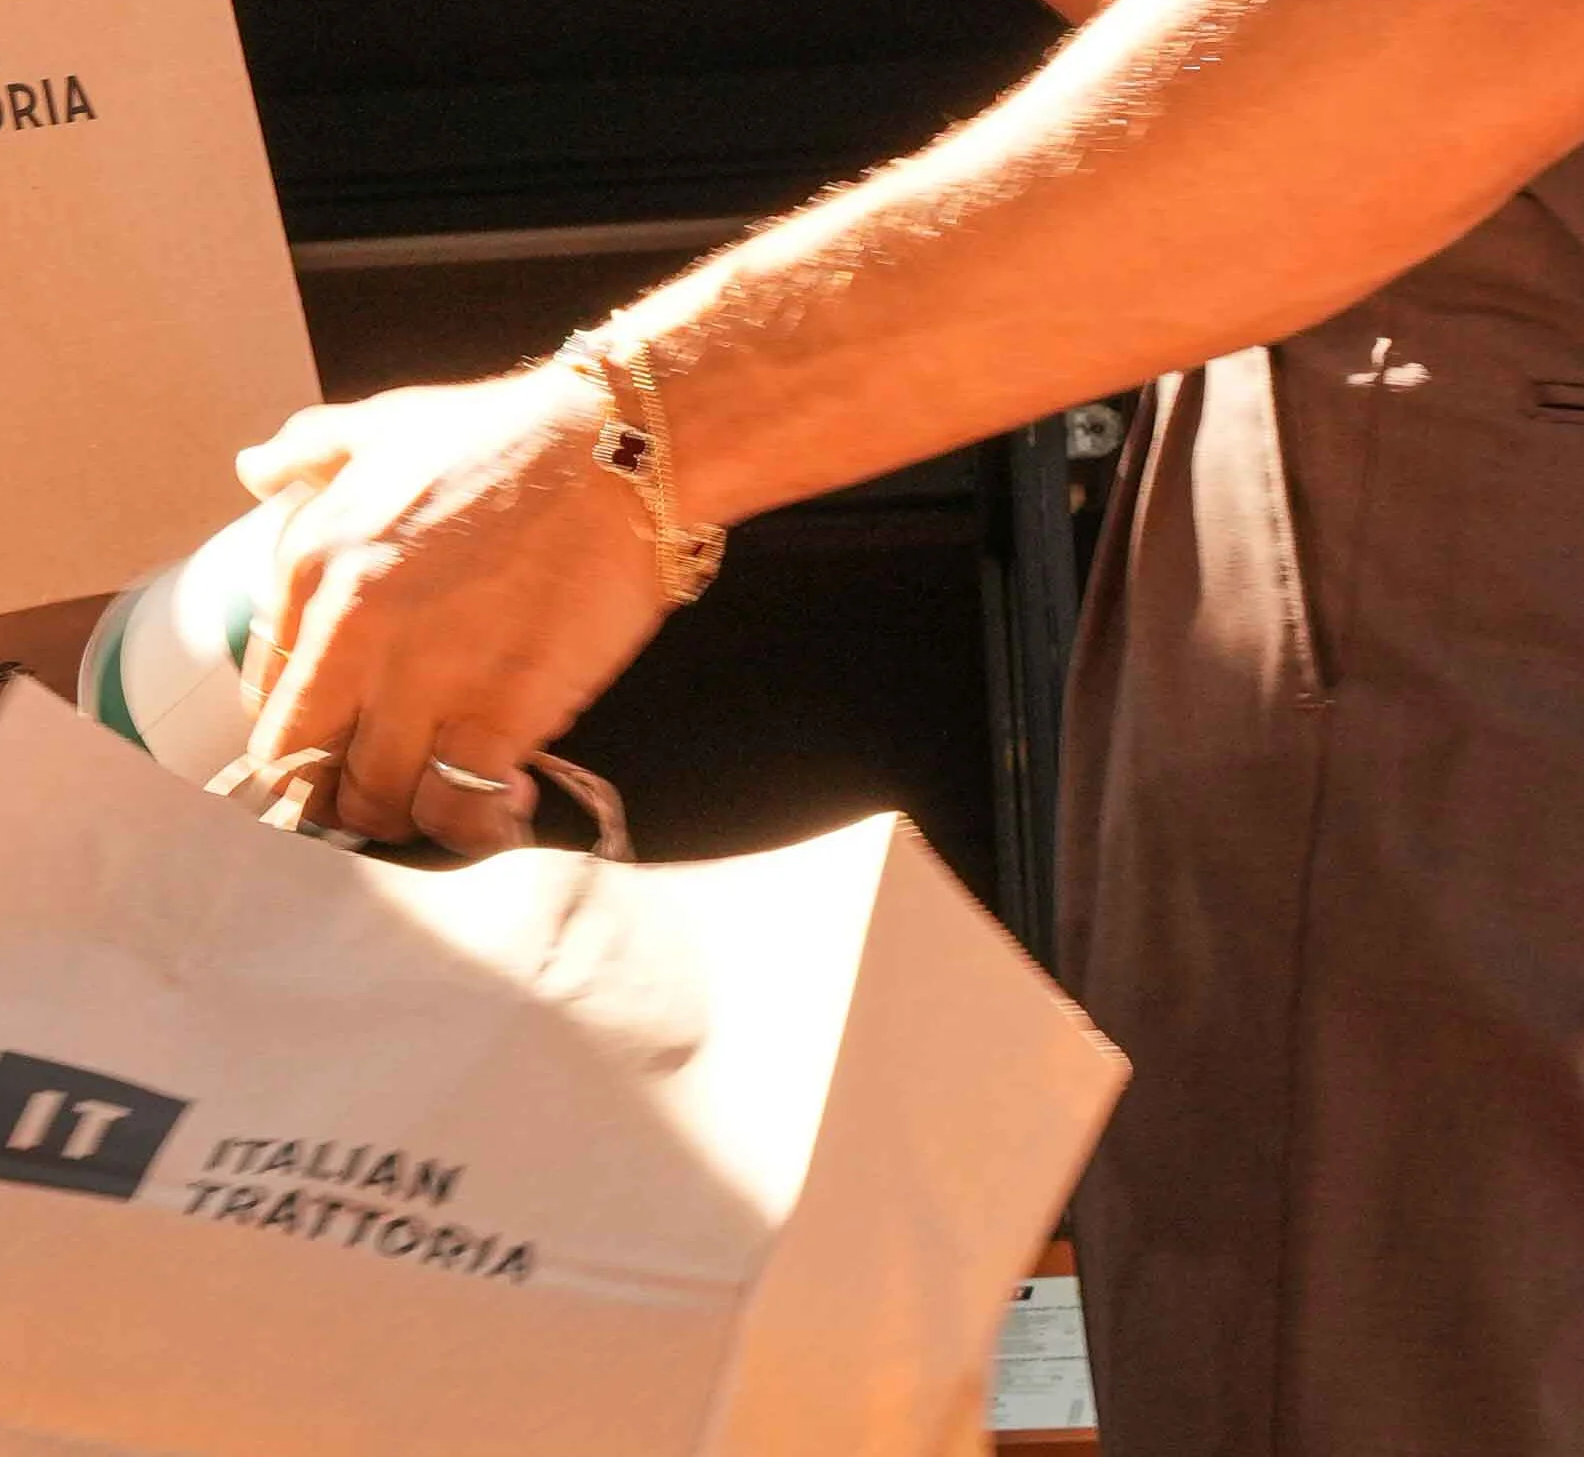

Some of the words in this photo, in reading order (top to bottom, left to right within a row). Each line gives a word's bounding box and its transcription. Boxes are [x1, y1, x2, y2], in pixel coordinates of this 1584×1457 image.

[4, 1087, 133, 1161] IT
[203, 1136, 468, 1207] ITALIAN
[182, 1178, 536, 1283] TRATTORIA
